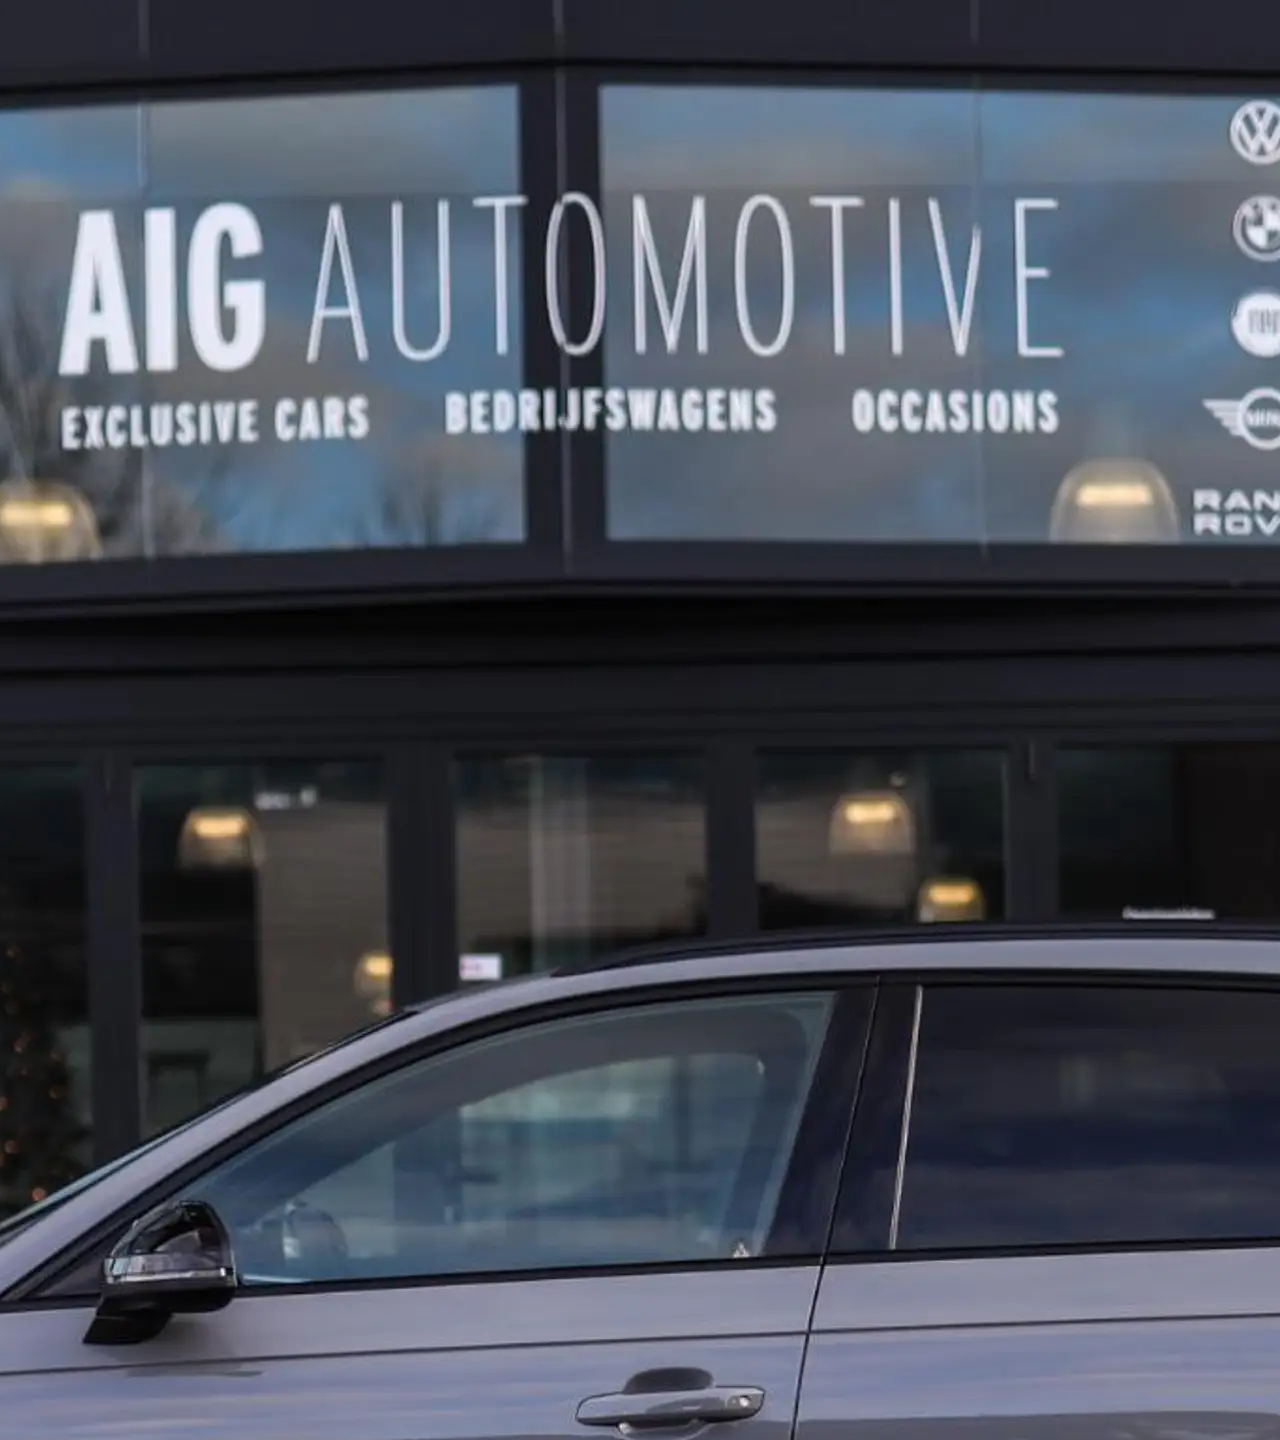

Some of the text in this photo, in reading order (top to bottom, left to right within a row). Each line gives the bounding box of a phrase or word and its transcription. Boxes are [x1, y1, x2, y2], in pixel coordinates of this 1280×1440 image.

[58, 193, 1064, 376] AIG AUTOMOTIVE
[61, 388, 1060, 450] EXCLUSIVE CARS BEDRIJFSWAGENS OCCASIONS
